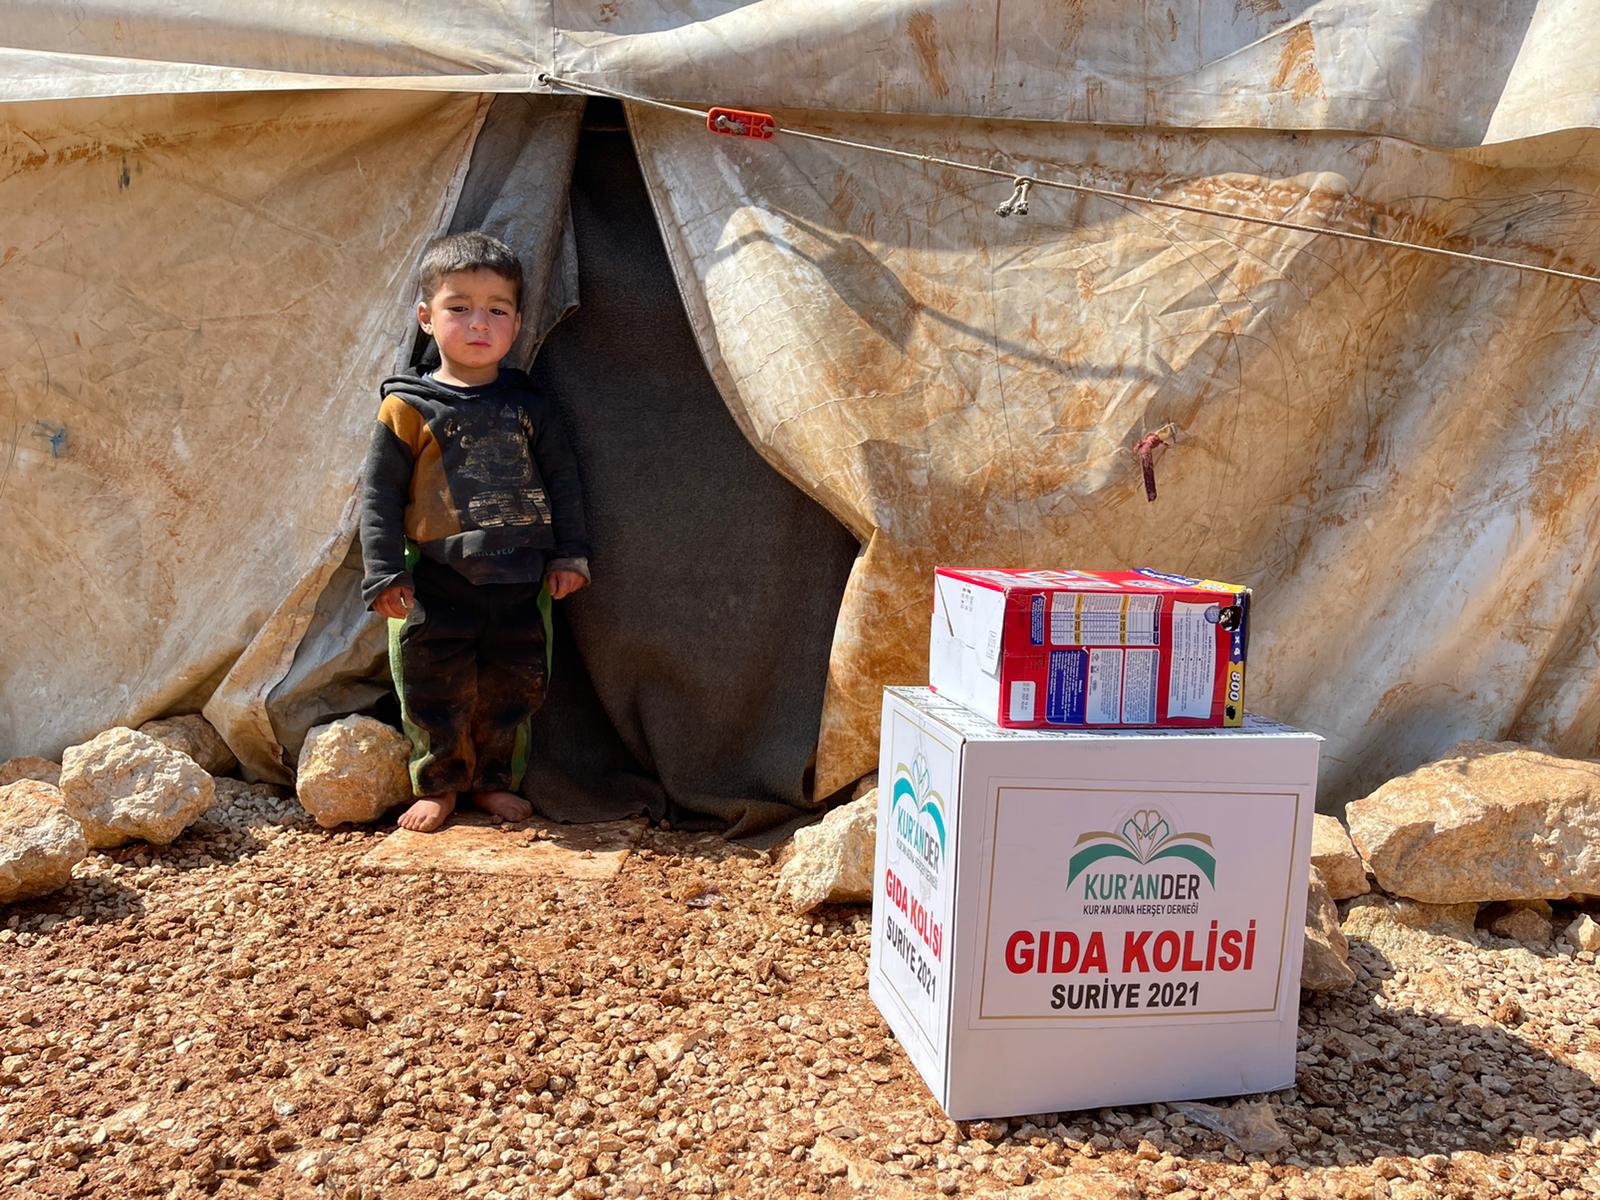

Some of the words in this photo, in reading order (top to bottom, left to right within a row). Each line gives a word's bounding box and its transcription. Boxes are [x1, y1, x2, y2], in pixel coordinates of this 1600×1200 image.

[1233, 646, 1241, 656] 4
[1229, 671, 1241, 702] 800
[897, 806, 940, 875] KUR'ANDER
[1083, 873, 1201, 901] KUR'ANDER
[885, 868, 908, 918] GIDA
[910, 894, 943, 963] KOLİSİ
[1083, 904, 1111, 915] KUR'AN
[1112, 904, 1135, 915] ADINA
[1136, 904, 1165, 917] HERŞEY
[1167, 902, 1199, 915] DERNEĞİ
[886, 915, 916, 974] SURİYE
[917, 954, 937, 1003] 2021
[1005, 930, 1108, 974] GIDA
[1122, 919, 1257, 973] KOLİSİ
[1050, 978, 1141, 1010] SURİYE
[1146, 981, 1200, 1008] 2021
